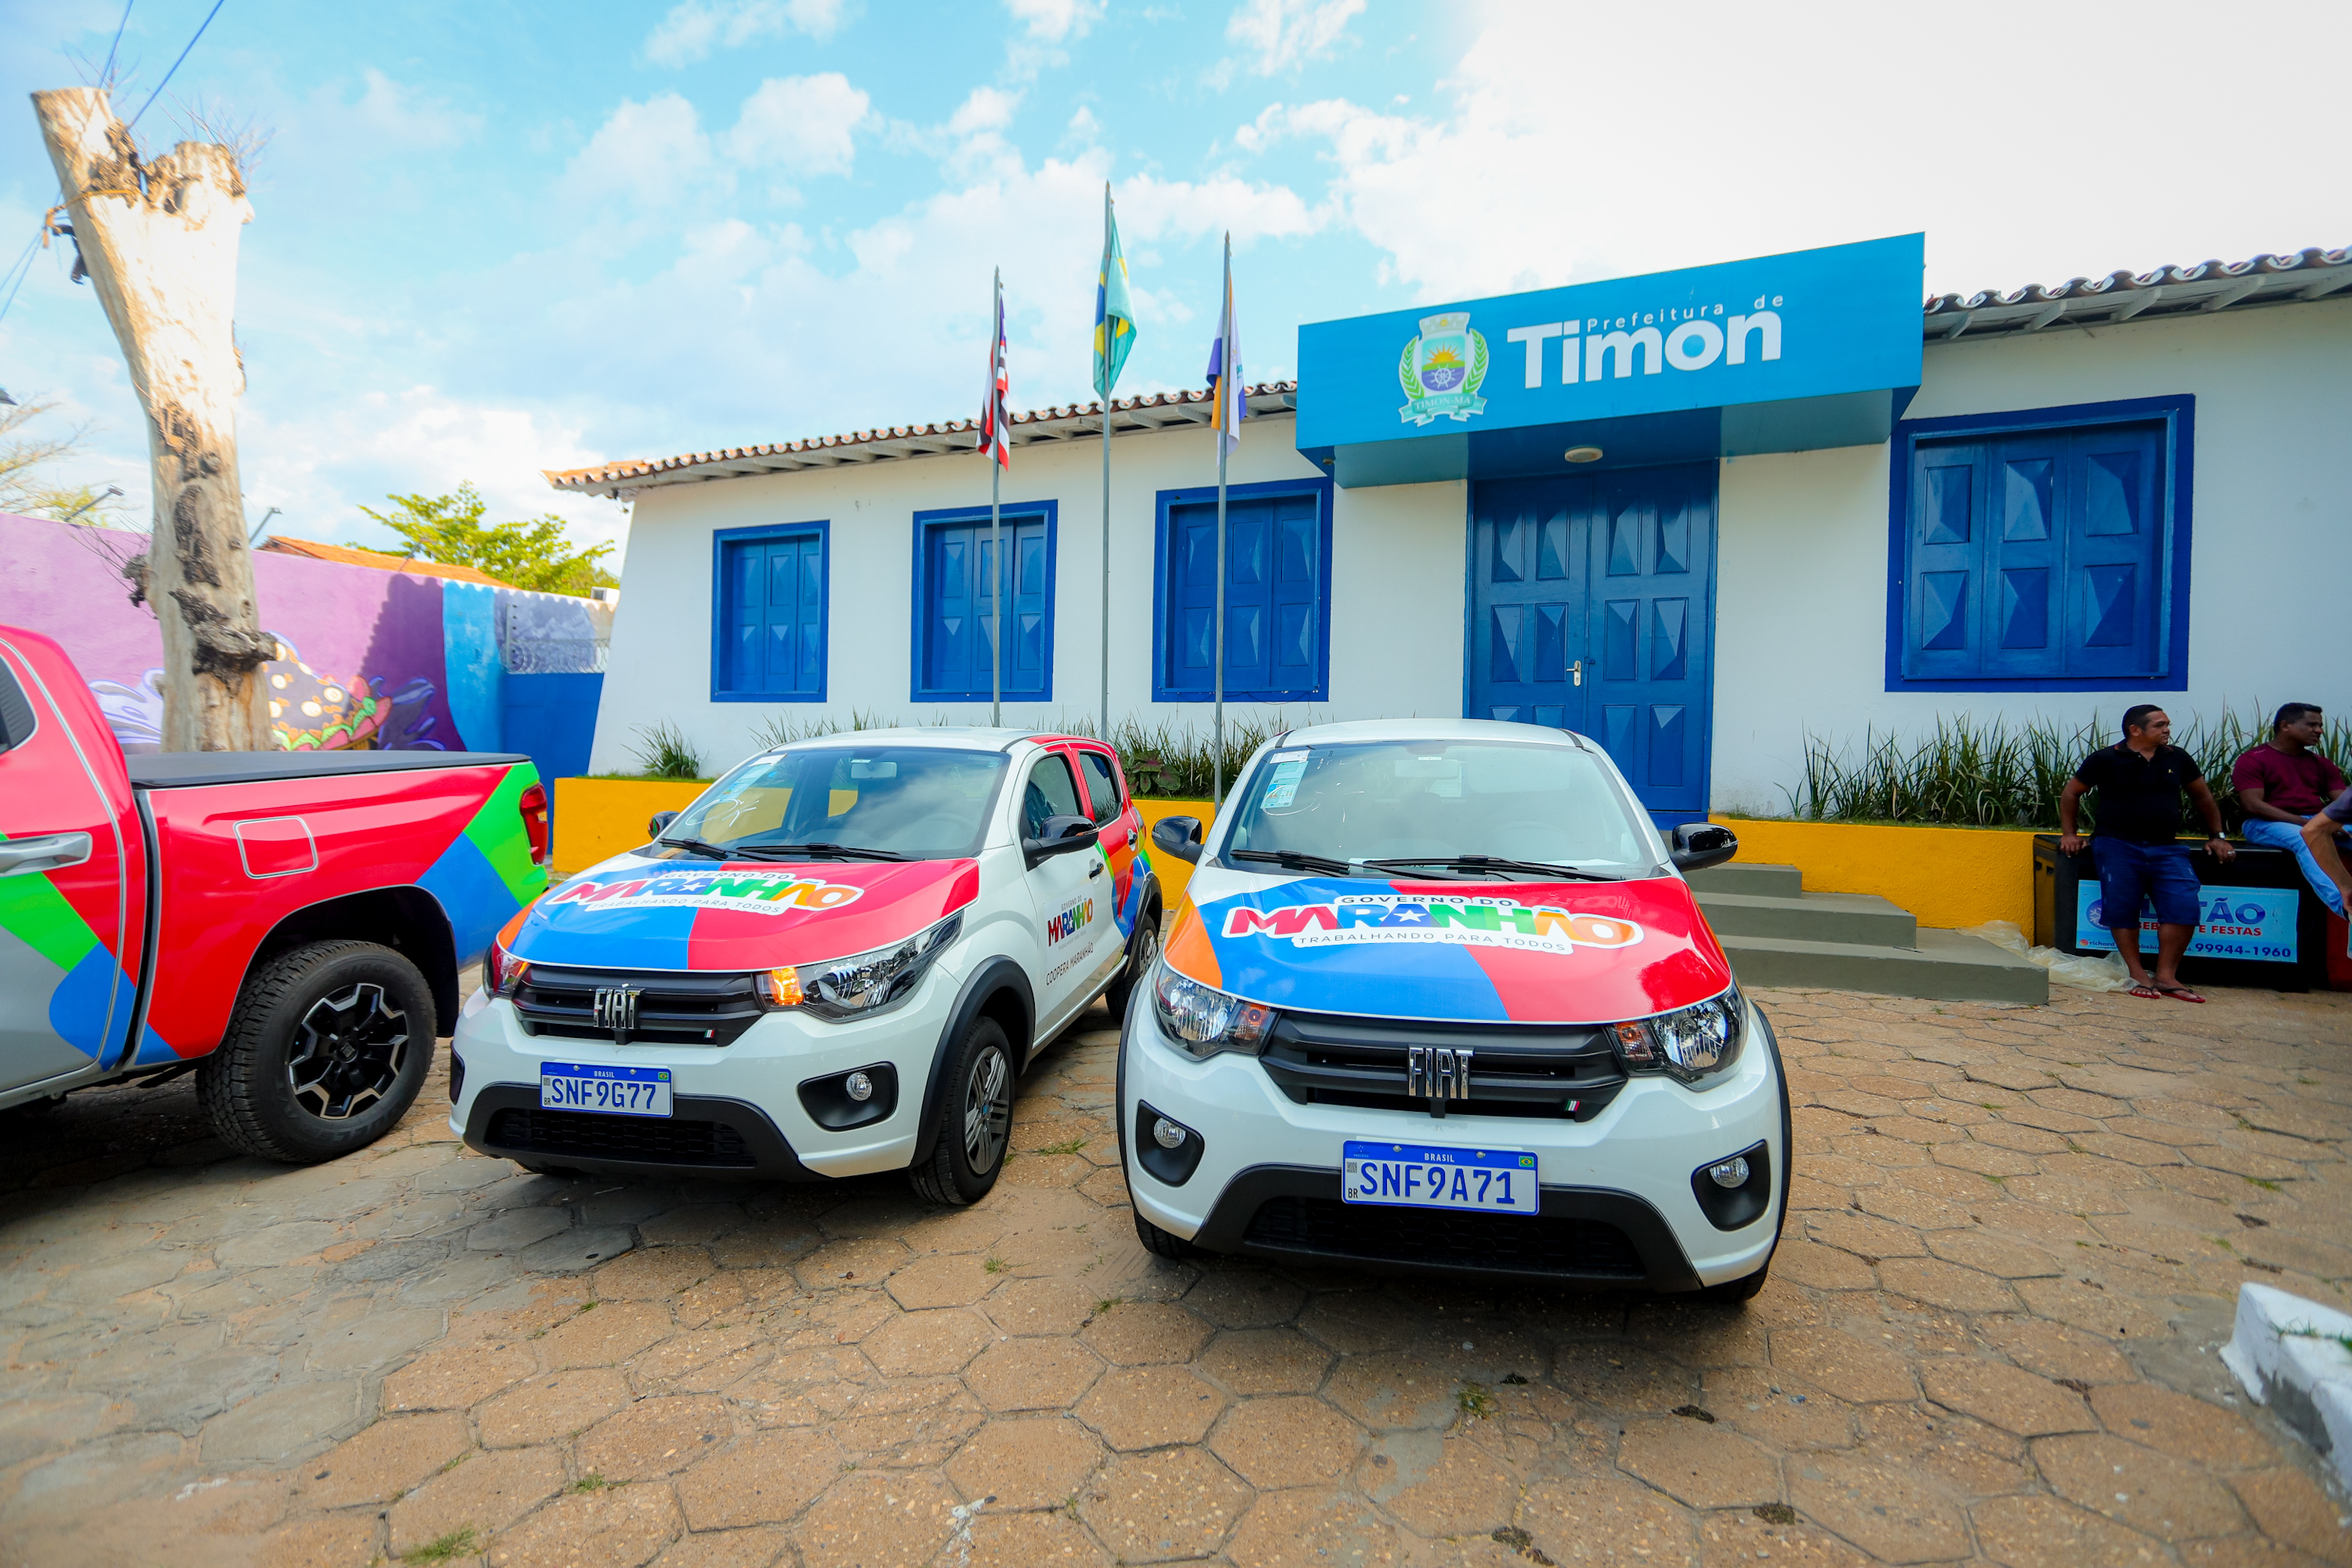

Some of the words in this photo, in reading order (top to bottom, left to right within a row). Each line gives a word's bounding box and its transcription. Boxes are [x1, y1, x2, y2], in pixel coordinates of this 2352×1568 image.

[1587, 303, 1724, 332] Prefeitura
[1754, 293, 1784, 310] de
[1507, 310, 1782, 389] Timon
[1414, 395, 1471, 410] TIMON-MA
[552, 877, 858, 909] MARANHÃO
[591, 898, 688, 909] TRABALHANDO
[735, 902, 781, 913] TODOS
[1229, 904, 1635, 945] MARANHÃO
[2211, 925, 2262, 936] FESTAS
[1299, 932, 1435, 944] TRABALHANDO
[1445, 933, 1493, 943] PARA
[1503, 937, 1565, 951] TODOS
[2194, 942, 2292, 957] 99944-1960
[1046, 961, 1069, 985] COOPERA
[1069, 942, 1094, 969] MARANHÃO
[593, 989, 641, 1029] FIAT
[1408, 1047, 1474, 1099] FIAT
[543, 1097, 551, 1106] BR
[551, 1078, 656, 1109] SNF9G77
[1424, 1152, 1455, 1163] BRASIL
[1348, 1188, 1359, 1199] BR
[1359, 1162, 1515, 1205] SNF9A71
